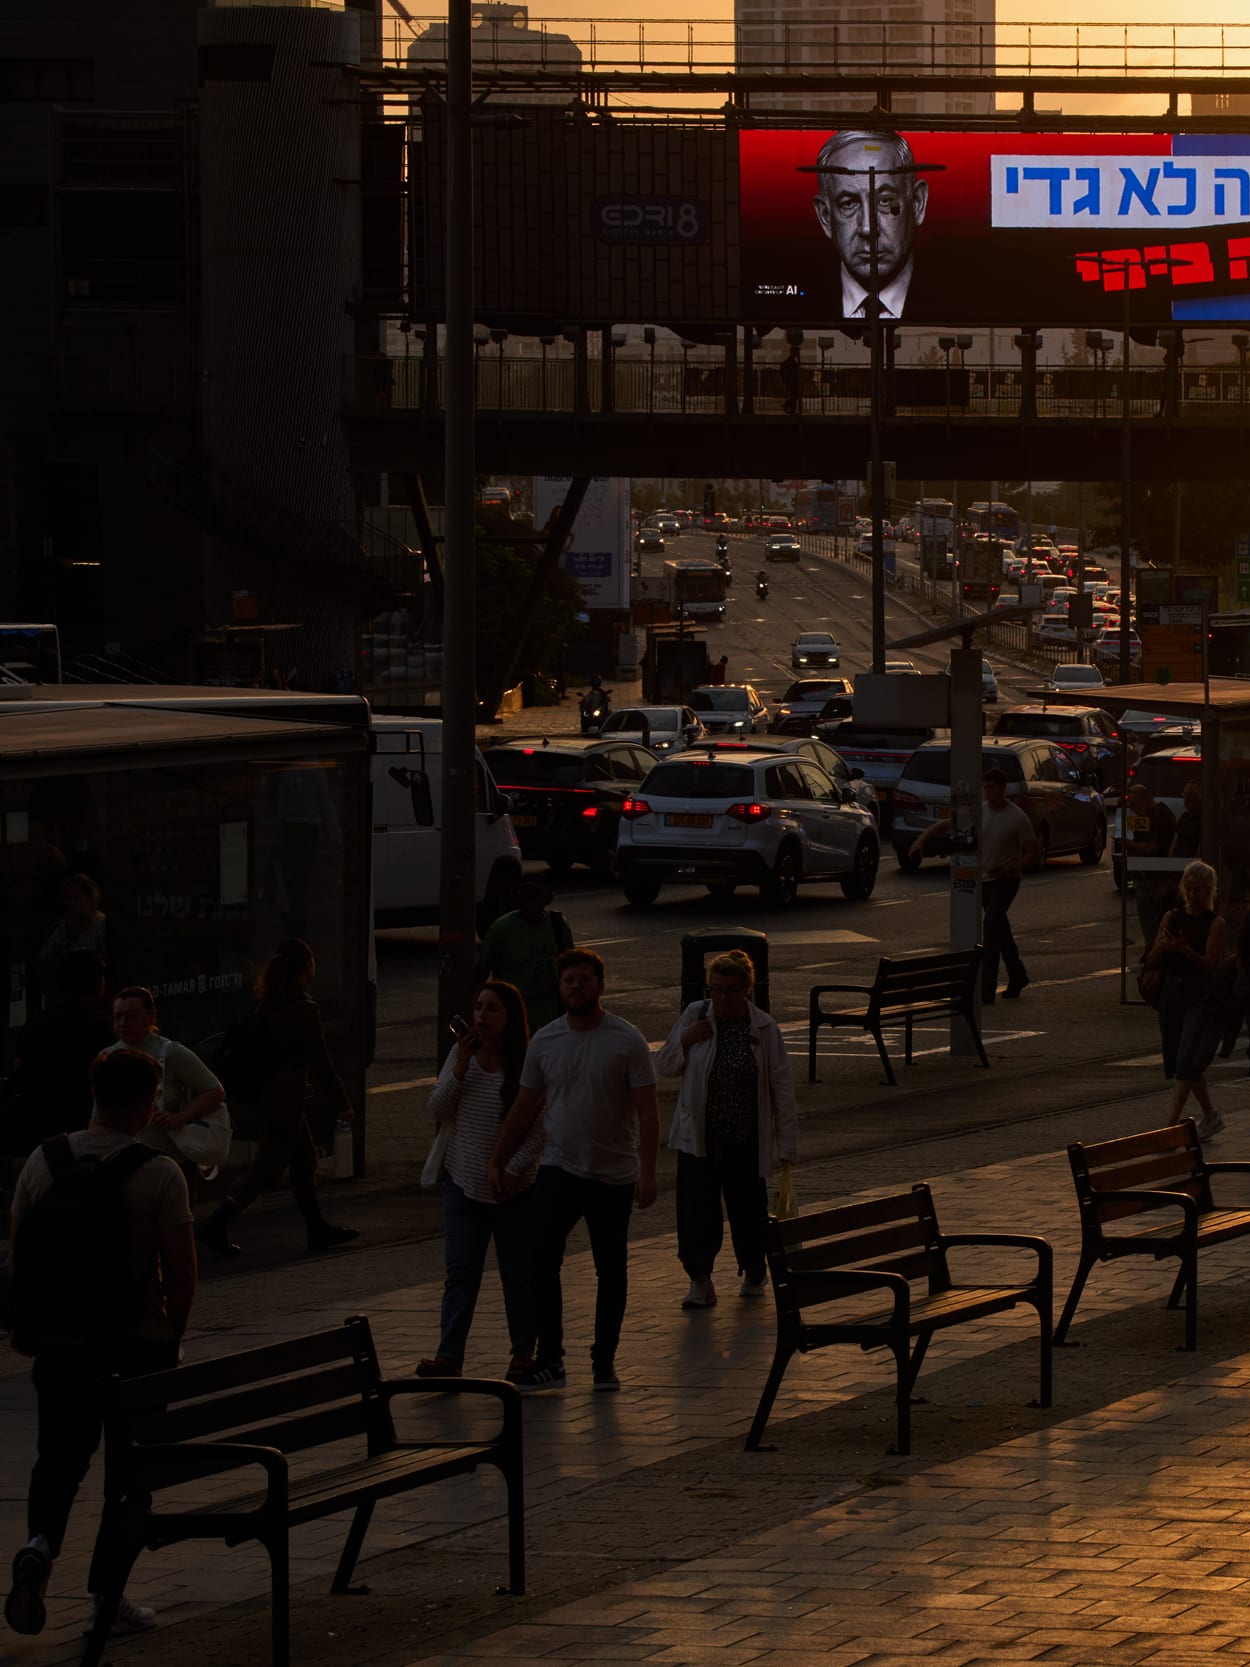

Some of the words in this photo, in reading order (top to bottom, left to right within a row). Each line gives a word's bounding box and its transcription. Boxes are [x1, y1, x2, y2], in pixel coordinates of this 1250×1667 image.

[1006, 167, 1100, 215] גדי
[1118, 161, 1197, 216] לא
[786, 285, 798, 295] AI
